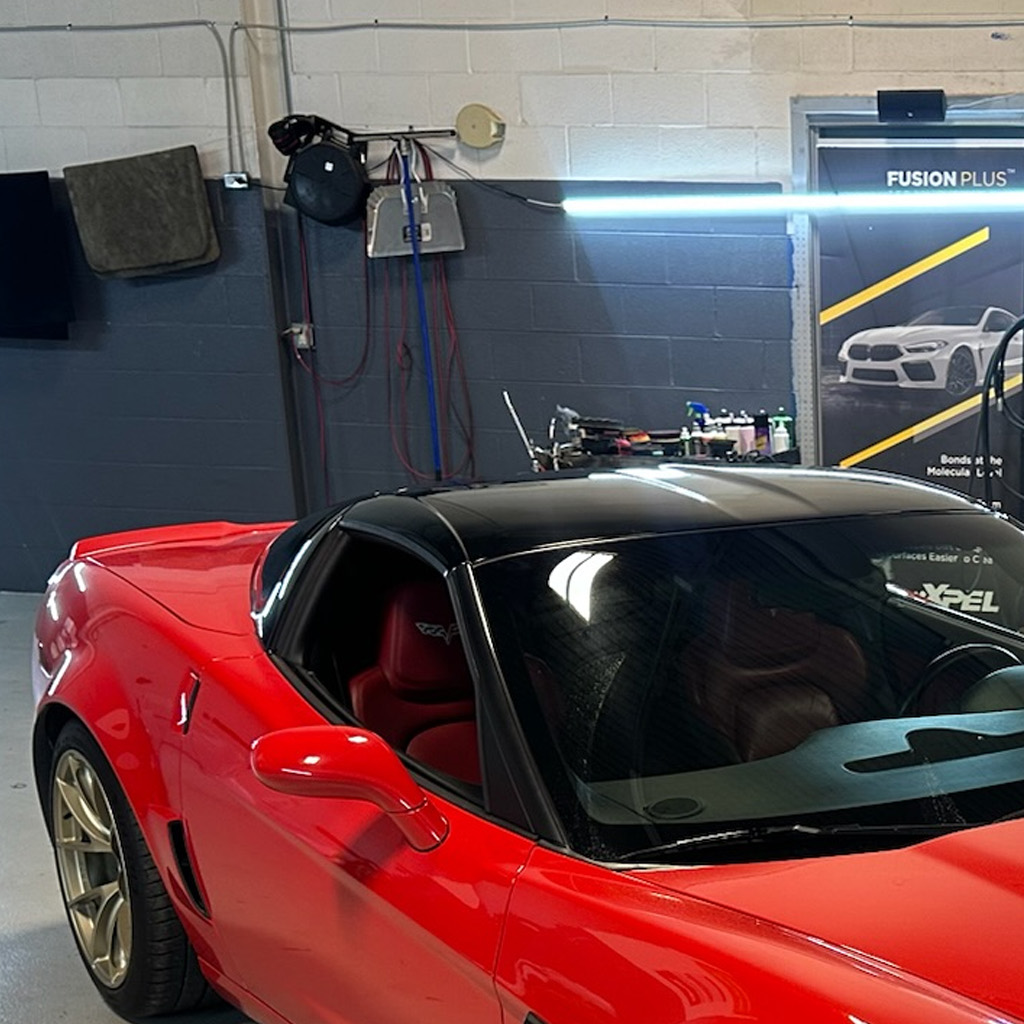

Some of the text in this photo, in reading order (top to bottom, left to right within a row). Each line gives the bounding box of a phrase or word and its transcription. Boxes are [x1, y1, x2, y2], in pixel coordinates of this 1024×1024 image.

[886, 170, 957, 188] FUSION
[940, 453, 973, 466] Bonds
[987, 455, 1004, 467] he
[926, 465, 974, 478] Molecula
[889, 551, 928, 562] urfaces
[928, 552, 959, 563] Easier
[922, 583, 1000, 613] XPEL
